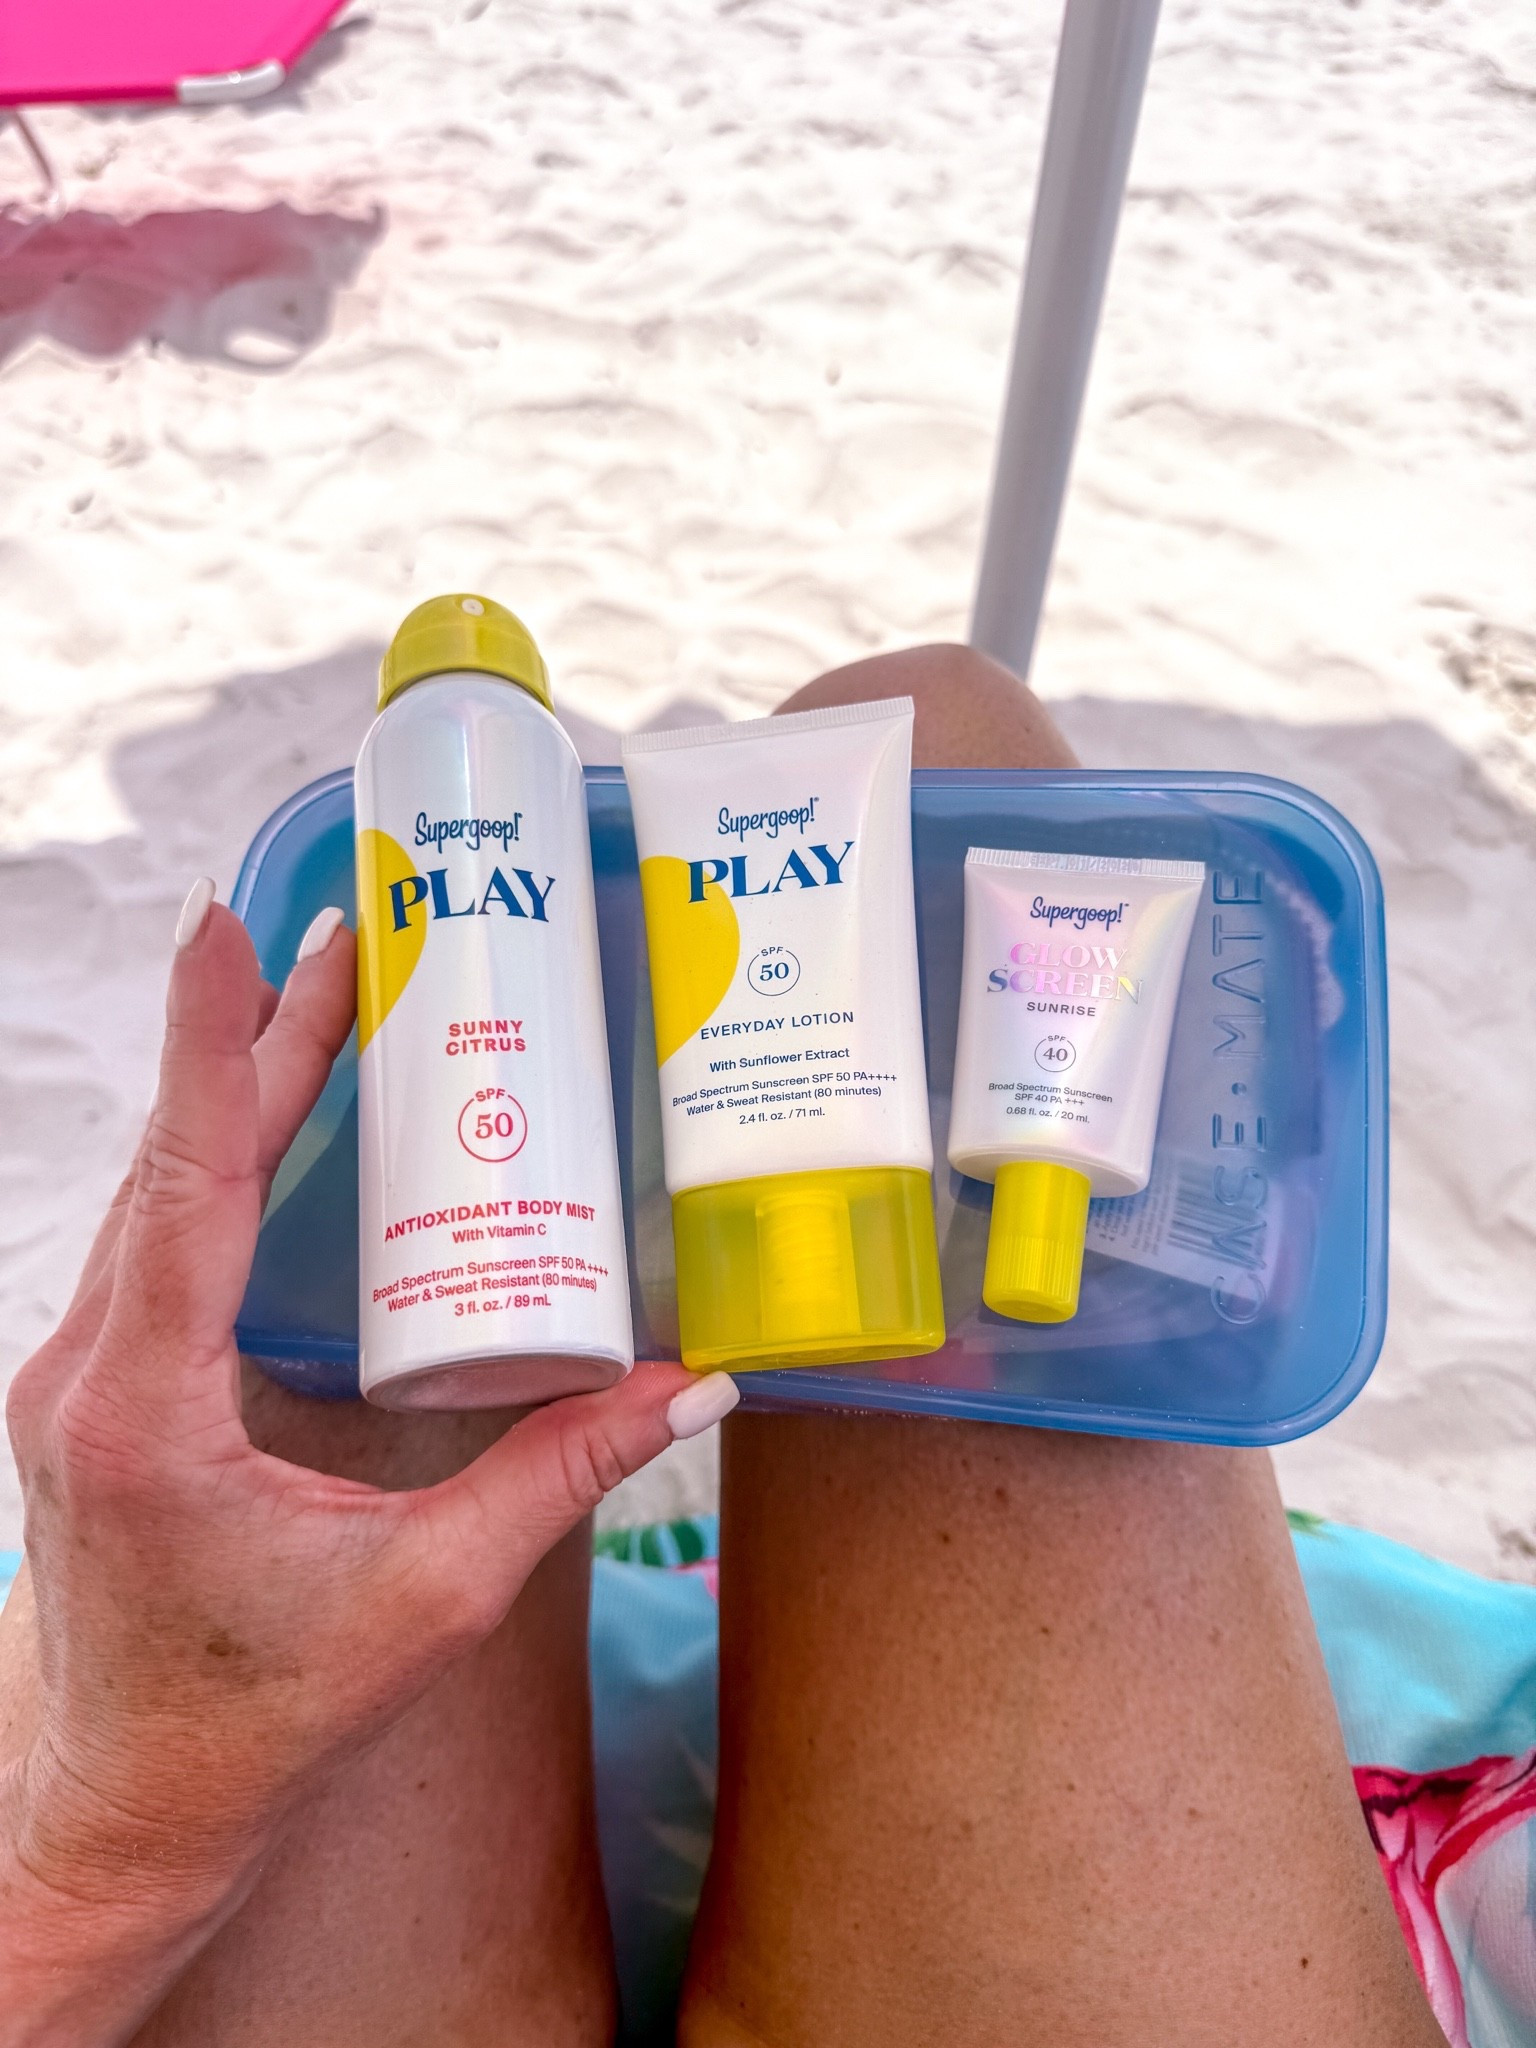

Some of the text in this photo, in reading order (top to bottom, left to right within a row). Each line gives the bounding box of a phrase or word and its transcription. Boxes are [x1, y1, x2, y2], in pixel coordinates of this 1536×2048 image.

[718, 797, 817, 842] Supergoop!
[415, 812, 521, 853] Supergoop!
[687, 841, 855, 903] PLAY
[388, 866, 556, 932] PLAY
[1030, 896, 1124, 932] Supergoop!
[760, 946, 784, 957] SPF
[1009, 942, 1129, 970] GLOW
[759, 962, 790, 982] 50
[986, 968, 1144, 1005] SCREEN
[1026, 1001, 1096, 1017] SUNRISE
[448, 1020, 523, 1037] SUNNY
[700, 1011, 855, 1040] EVERYDAY LOTION
[446, 1038, 526, 1056] CITRUS
[1047, 1034, 1067, 1043] SPF
[709, 1048, 850, 1073] With Sunflower Extract
[1042, 1047, 1068, 1062] 40
[475, 1087, 506, 1102] SPF
[672, 1091, 698, 1107] Broad
[699, 1083, 750, 1100] Spectrum
[752, 1076, 810, 1090] Sunscreen
[811, 1072, 834, 1084] SPF
[835, 1071, 851, 1082] 50
[686, 1086, 882, 1117] Water & Sweat Resistant (80 minutes)
[988, 1082, 1113, 1103] Broad Spectrum Sunscreen
[1014, 1092, 1034, 1101] SPF
[1034, 1094, 1048, 1102] 40
[474, 1112, 514, 1139] 50
[739, 1114, 756, 1125] 2.4
[758, 1112, 768, 1123] fl.
[770, 1111, 787, 1121] oz.
[795, 1108, 807, 1118] 71
[808, 1106, 826, 1117] ml.
[1006, 1106, 1026, 1115] 0.68
[1061, 1111, 1074, 1120] 20
[384, 1199, 596, 1242] ANTIOXIDANT BODY MIST
[452, 1223, 547, 1244] With Vitamin C
[372, 1280, 400, 1302] Broad
[401, 1266, 464, 1291] Spectrum
[467, 1257, 537, 1275] Sunscreen
[538, 1255, 561, 1269] SPF
[561, 1256, 574, 1270] 50
[387, 1272, 598, 1313] Water & Sweat Resistant (80 minutes)
[454, 1303, 465, 1317] 3
[467, 1300, 480, 1315] fl.
[483, 1299, 504, 1313] oz.
[505, 1295, 512, 1310] /
[514, 1294, 531, 1308] 89
